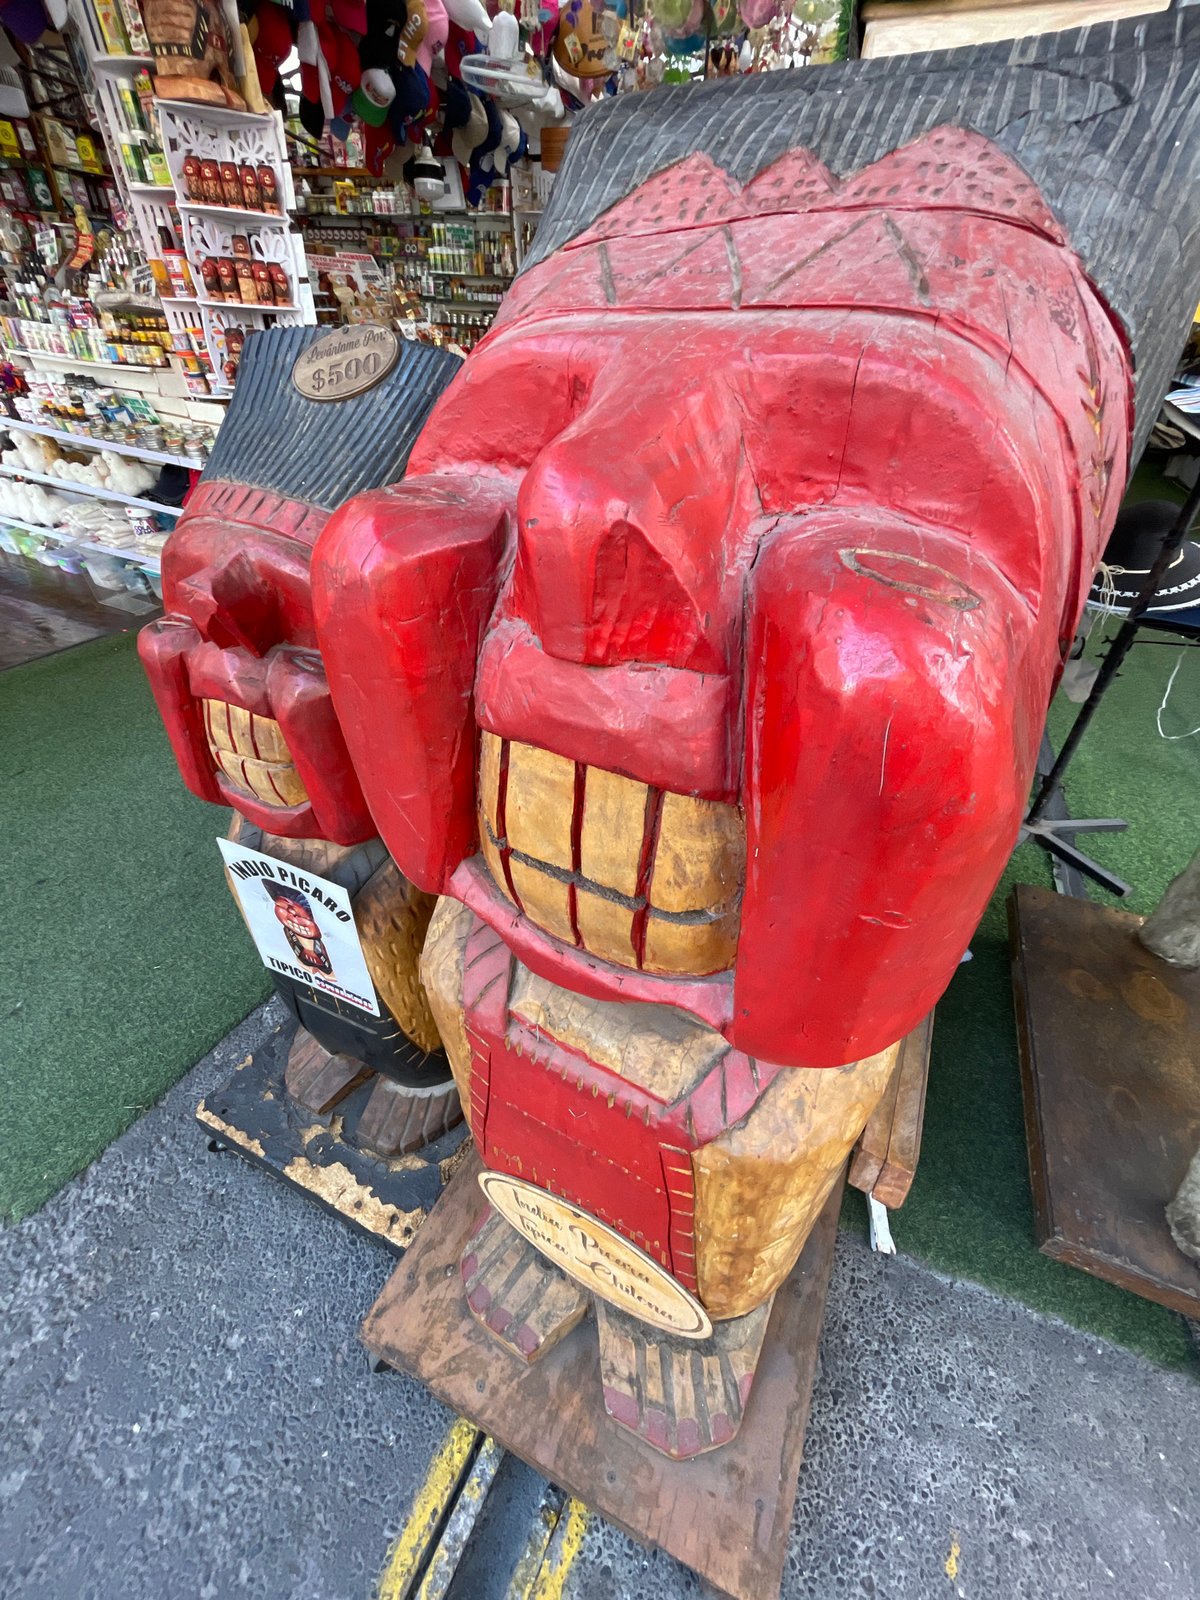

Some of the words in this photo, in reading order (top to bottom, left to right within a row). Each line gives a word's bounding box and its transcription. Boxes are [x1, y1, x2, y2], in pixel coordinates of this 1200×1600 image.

[397, 13, 422, 60] CHILE
[306, 338, 361, 363] Levántame
[363, 330, 387, 347] Por:
[312, 352, 382, 392] $500
[229, 860, 275, 880] INDIO
[277, 866, 352, 923] PICARO
[267, 955, 313, 983] TIPICO
